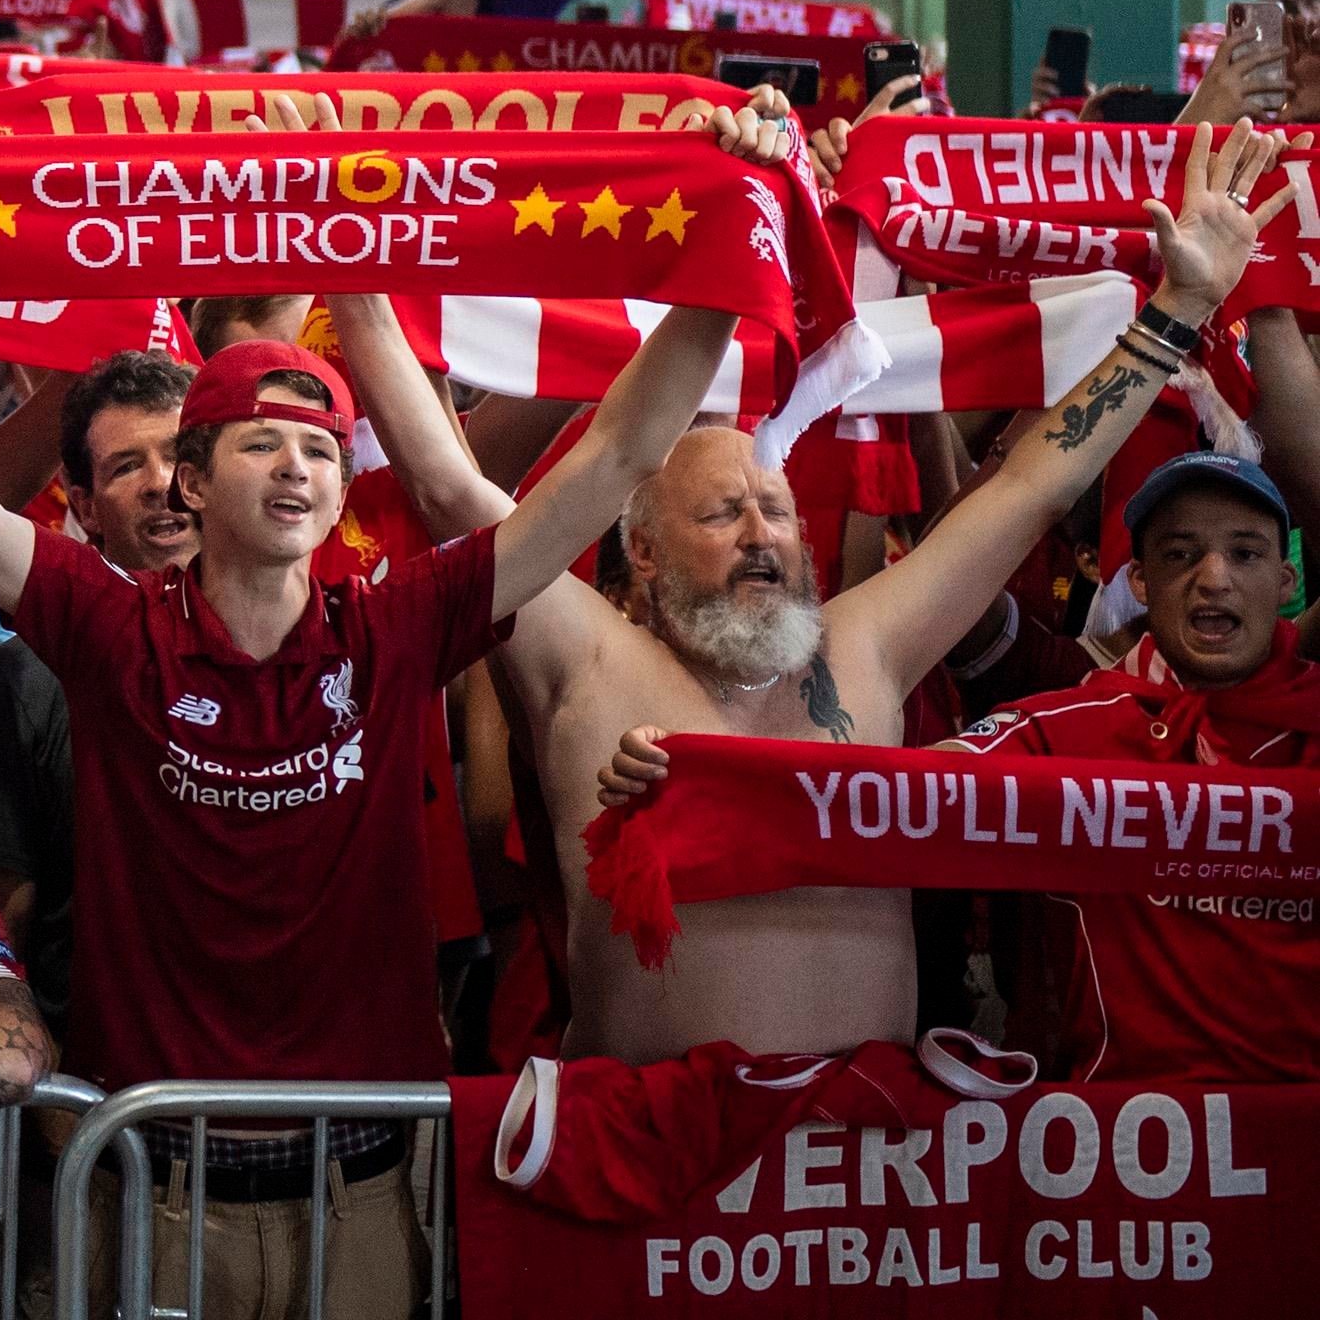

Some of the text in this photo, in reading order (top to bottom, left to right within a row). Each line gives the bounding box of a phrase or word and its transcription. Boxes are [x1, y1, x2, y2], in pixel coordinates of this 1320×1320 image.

[903, 129, 1178, 207] ANFIELD
[67, 212, 461, 270] OF EUROPE
[897, 208, 1120, 269] NEVER
[159, 763, 328, 812] Chartered
[796, 771, 1294, 854] YOU'LL NEVER
[1155, 862, 1191, 878] LFC
[1198, 863, 1283, 880] OFFICIAL
[719, 1092, 1267, 1214] ERPOOL
[646, 1220, 1213, 1297] FOOTBALL CLUB
